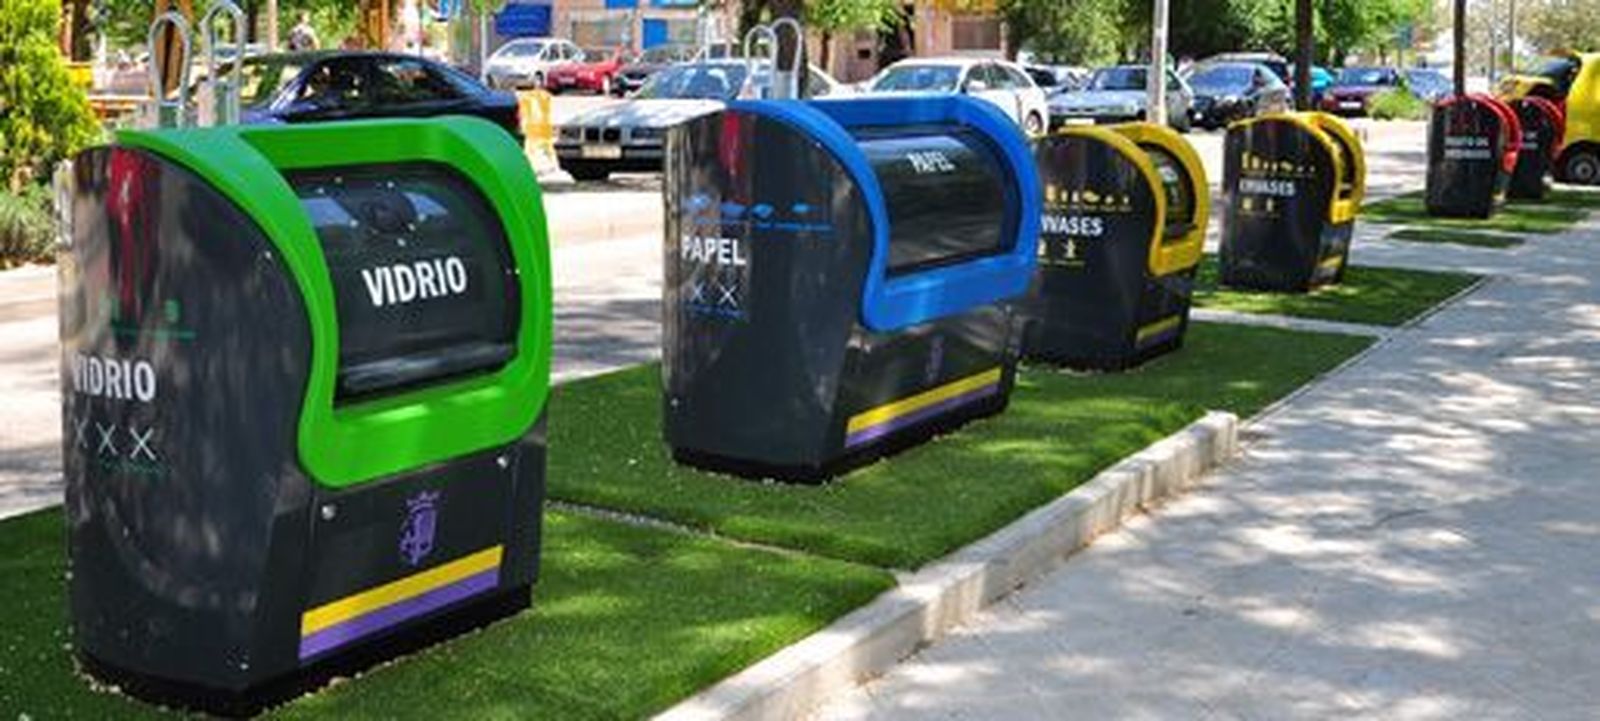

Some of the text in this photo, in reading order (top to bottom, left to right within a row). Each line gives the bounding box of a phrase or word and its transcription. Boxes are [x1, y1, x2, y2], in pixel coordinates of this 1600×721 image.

[681, 236, 747, 265] PAPEL
[361, 257, 467, 307] VIDRIO
[71, 353, 156, 402] VIDRIO
